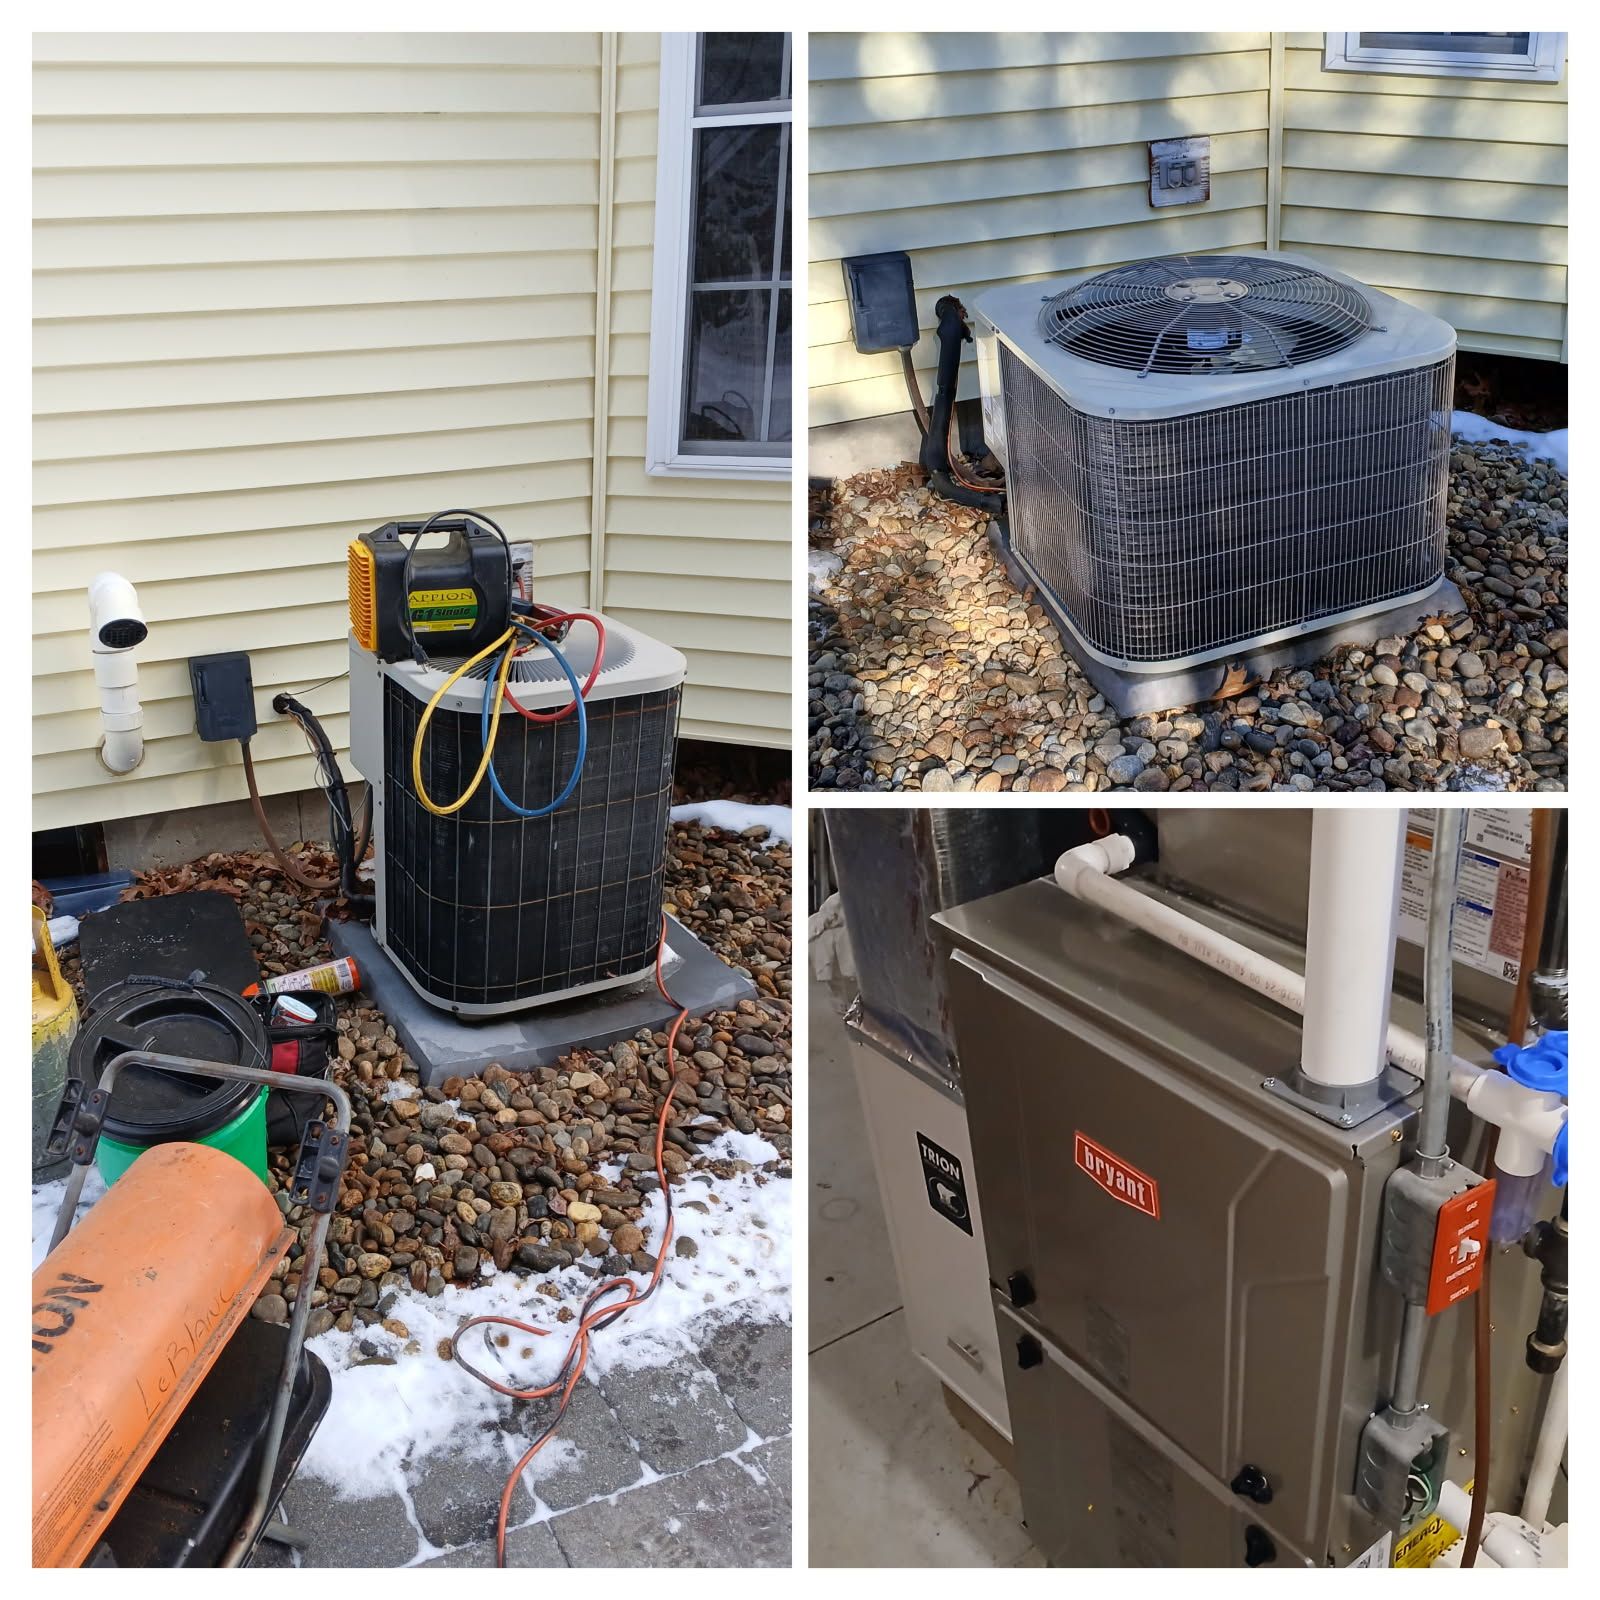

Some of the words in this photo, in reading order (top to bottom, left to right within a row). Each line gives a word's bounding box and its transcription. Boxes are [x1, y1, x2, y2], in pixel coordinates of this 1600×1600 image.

[409, 592, 473, 602] APPION
[921, 1143, 960, 1180] TRION
[1084, 1145, 1145, 1206] bryant
